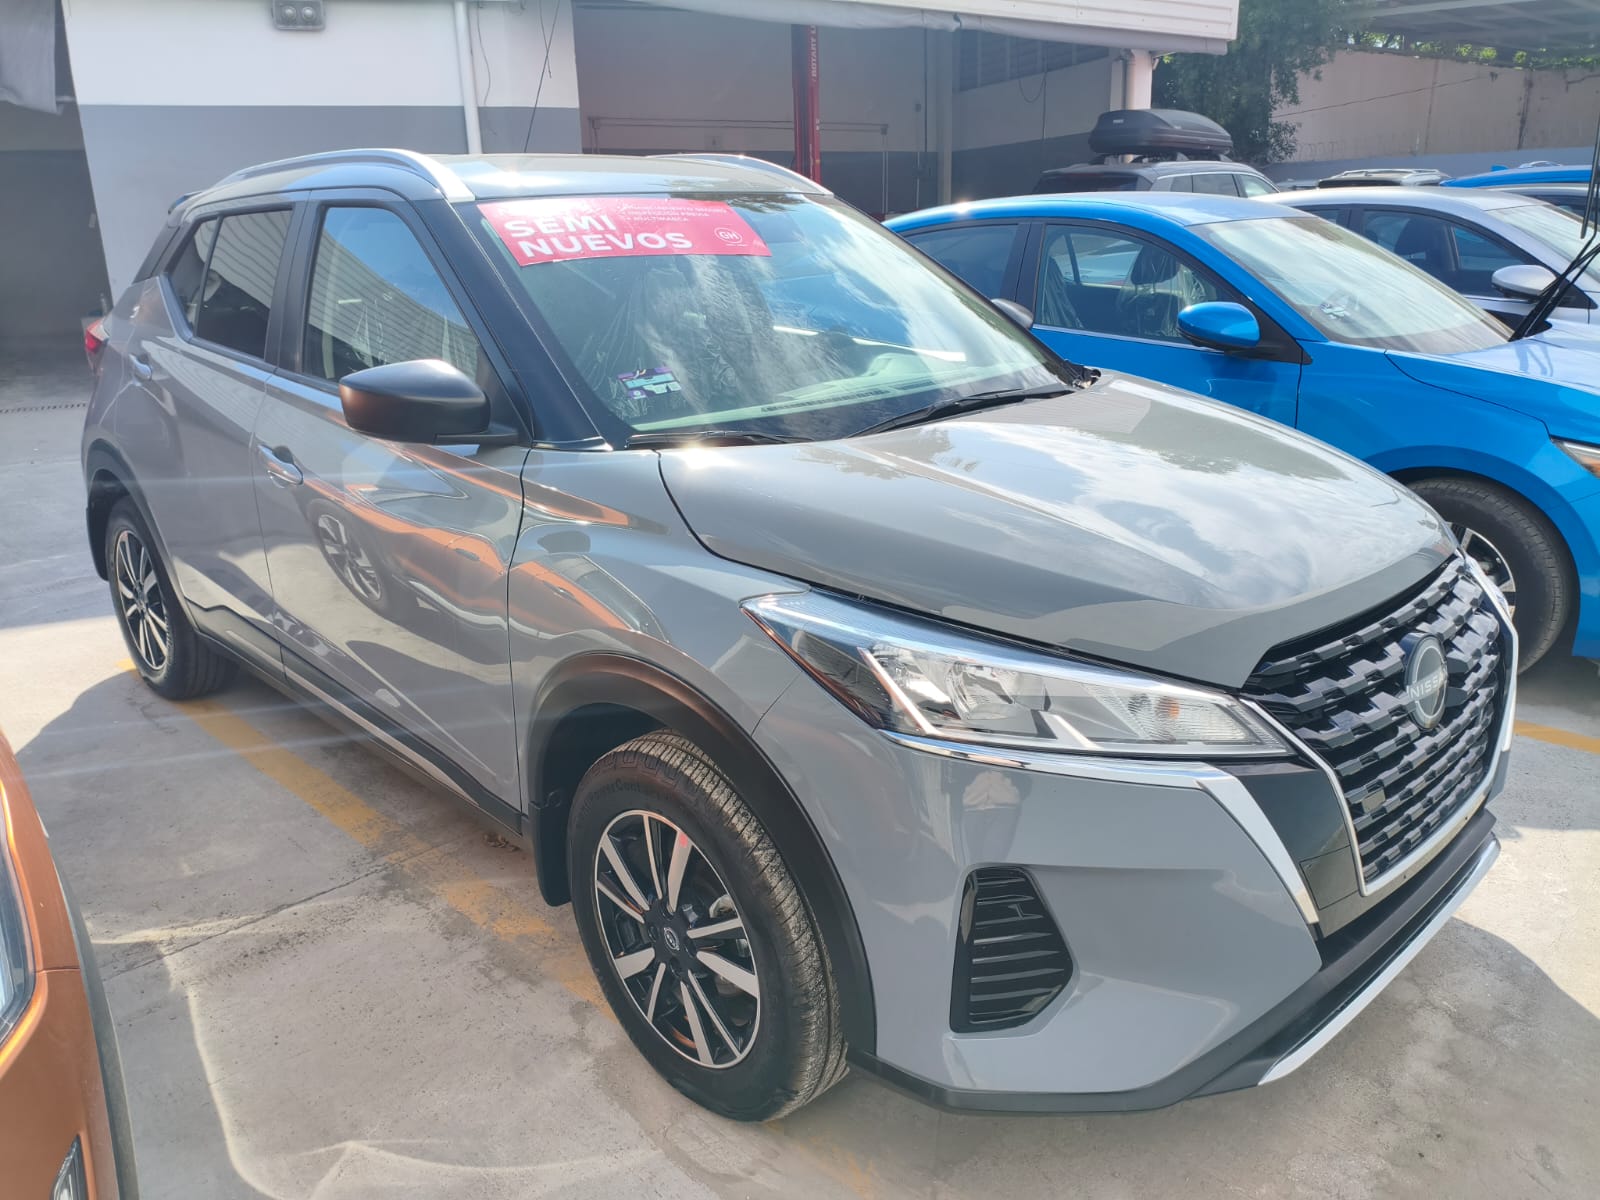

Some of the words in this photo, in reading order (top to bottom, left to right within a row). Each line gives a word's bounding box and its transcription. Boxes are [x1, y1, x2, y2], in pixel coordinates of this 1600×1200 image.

[503, 214, 617, 237] SEMI
[517, 232, 693, 257] NUEVOS
[1410, 669, 1444, 699] NISS
